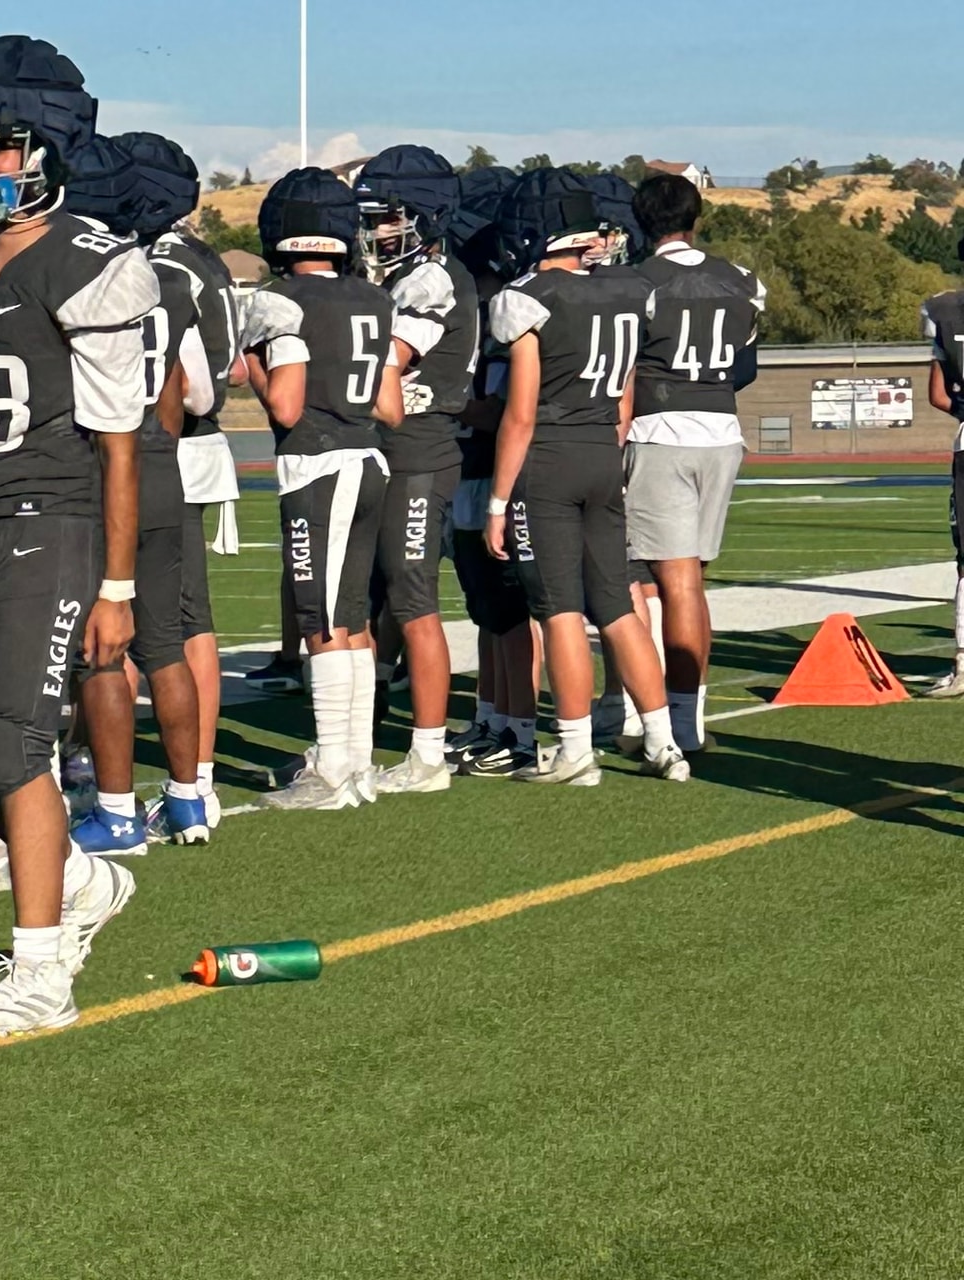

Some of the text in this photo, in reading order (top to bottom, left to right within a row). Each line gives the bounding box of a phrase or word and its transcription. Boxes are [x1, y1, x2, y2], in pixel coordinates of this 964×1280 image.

[346, 315, 379, 404] 5
[579, 313, 639, 398] 40
[671, 308, 735, 381] 44
[291, 517, 314, 582] EAGLES
[405, 497, 428, 561] EAGLES
[512, 500, 535, 562] EAGLES
[42, 598, 82, 698] EAGLES
[229, 952, 258, 979] G
